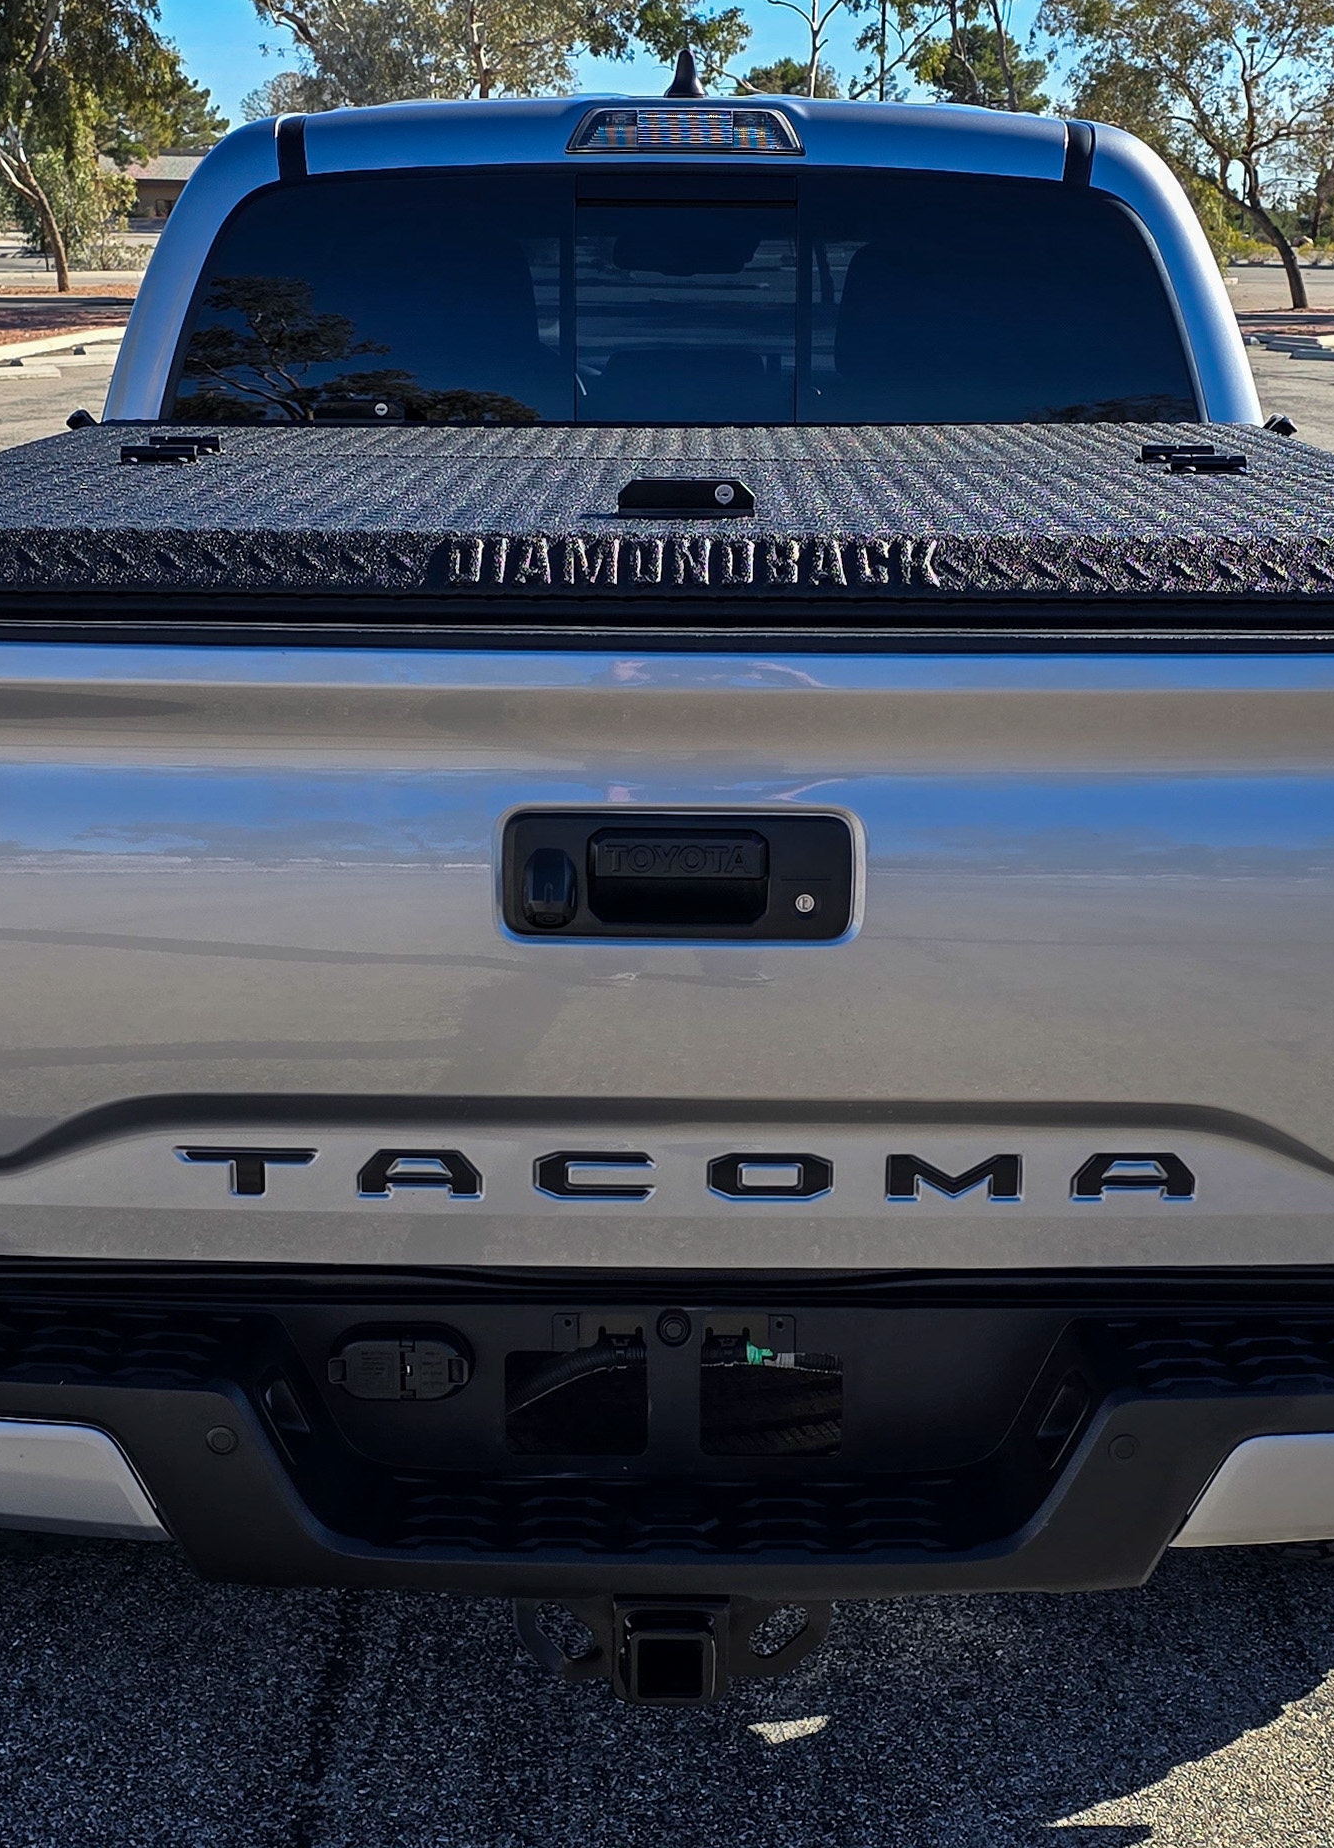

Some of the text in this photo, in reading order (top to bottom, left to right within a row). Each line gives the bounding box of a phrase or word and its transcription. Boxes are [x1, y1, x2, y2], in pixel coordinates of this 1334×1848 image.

[448, 537, 941, 586] DIAMONDBACK
[605, 844, 752, 874] TOYOTA
[175, 1146, 1197, 1202] TACOMA
